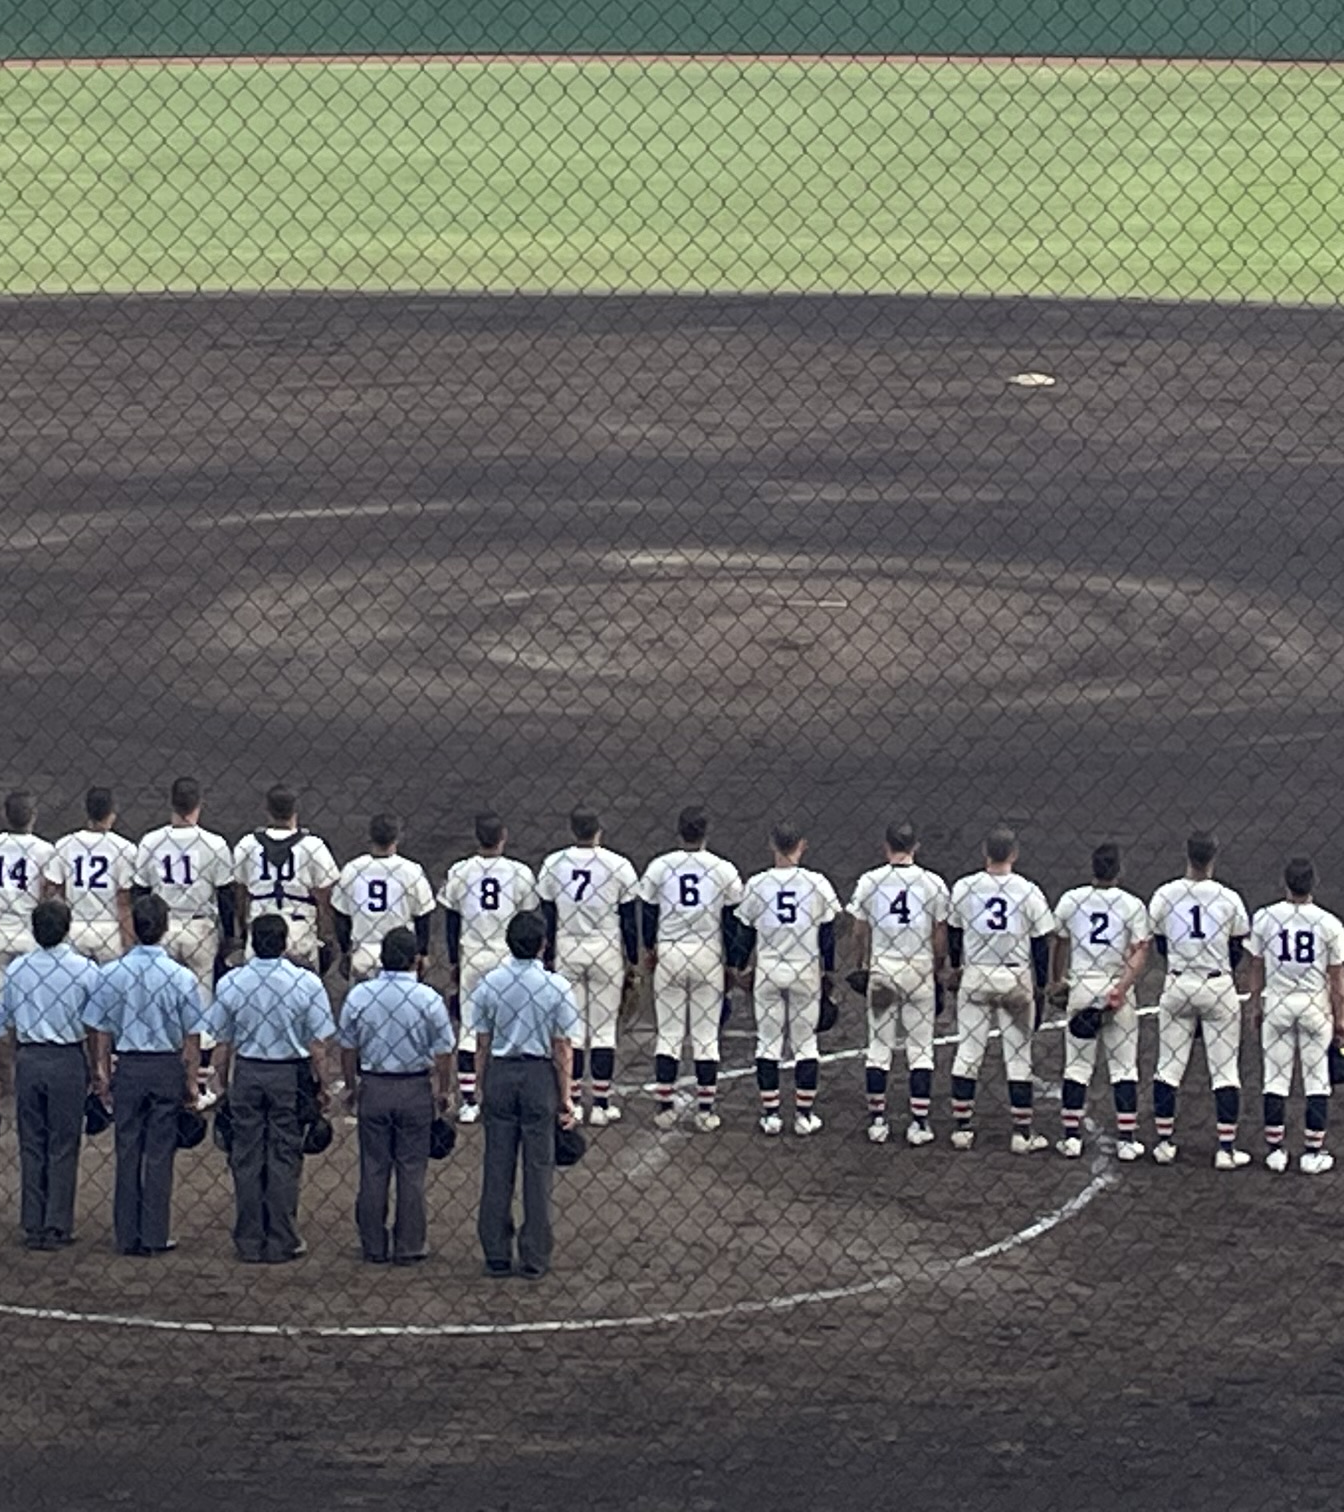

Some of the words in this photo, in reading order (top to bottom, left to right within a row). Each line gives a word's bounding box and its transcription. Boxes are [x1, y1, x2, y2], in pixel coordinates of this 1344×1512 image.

[73, 855, 110, 888] 12
[161, 855, 194, 885] 11
[571, 870, 592, 902] 7
[368, 879, 388, 913] 9
[480, 877, 500, 911] 8
[679, 874, 699, 907] 6
[776, 890, 798, 925] 5
[889, 890, 911, 925] 4
[986, 897, 1008, 932] 3
[1089, 912, 1111, 945] 2
[1188, 904, 1207, 940] 1
[1278, 929, 1316, 964] 18
